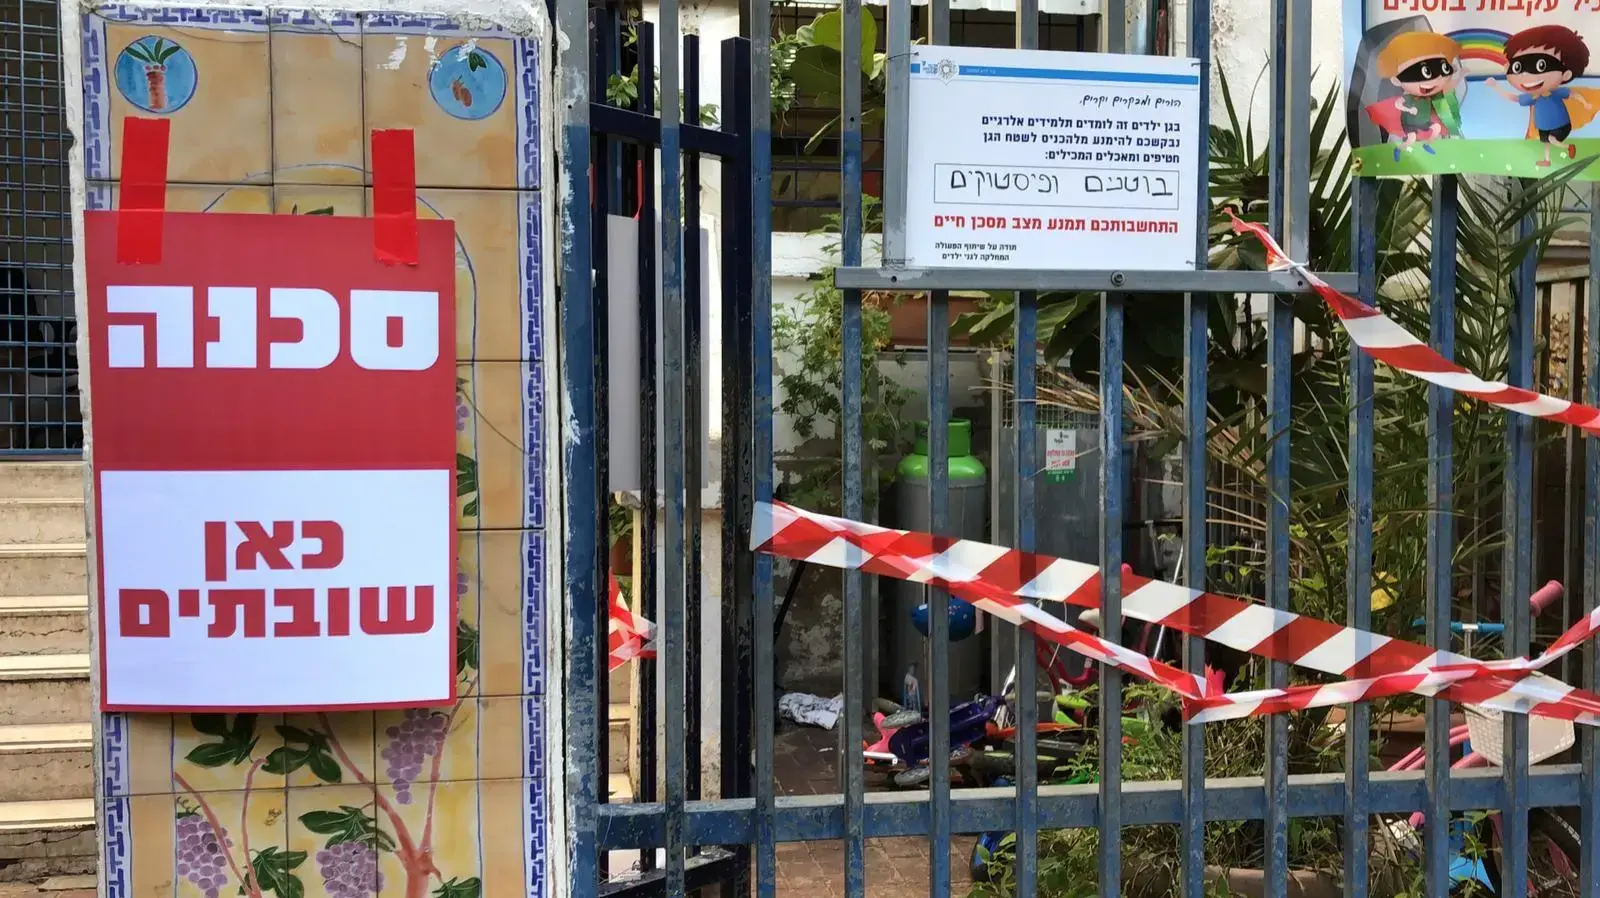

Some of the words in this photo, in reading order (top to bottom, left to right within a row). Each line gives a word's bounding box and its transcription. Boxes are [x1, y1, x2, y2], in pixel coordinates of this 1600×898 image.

[1154, 97, 1182, 109] הורים
[981, 115, 1024, 126] אלרגיים
[1027, 114, 1073, 129] תלמידים
[1075, 116, 1113, 130] לומדים
[1116, 119, 1128, 130] זה
[1131, 119, 1161, 132] ילדים
[1164, 122, 1181, 133] בגן
[983, 131, 1001, 143] הגן
[1004, 130, 1037, 143] לשטח
[1041, 131, 1088, 145] מלהכניס
[1092, 133, 1132, 147] להימנע
[1136, 137, 1180, 149] נבקשכם
[1044, 147, 1093, 162] המכילים:
[1095, 149, 1140, 163] ומאכלים
[1142, 154, 1180, 165] חטיפים
[950, 169, 1060, 197] ופיסטוקים
[1085, 175, 1174, 197] בוטנים
[934, 215, 966, 228] חיים
[970, 216, 1007, 231] מסכן
[1011, 216, 1042, 230] מצב
[1046, 217, 1086, 232] תמנע
[1091, 220, 1179, 234] התחשבותכם
[934, 241, 962, 249] הפעולה
[963, 242, 986, 251] שיתוף
[987, 242, 998, 250] על
[999, 243, 1017, 251] תודה
[942, 252, 962, 260] ילדים
[980, 253, 1010, 261] המחלקה
[106, 285, 440, 371] סכנה
[204, 520, 344, 582] כאן
[118, 585, 435, 639] שובתים
